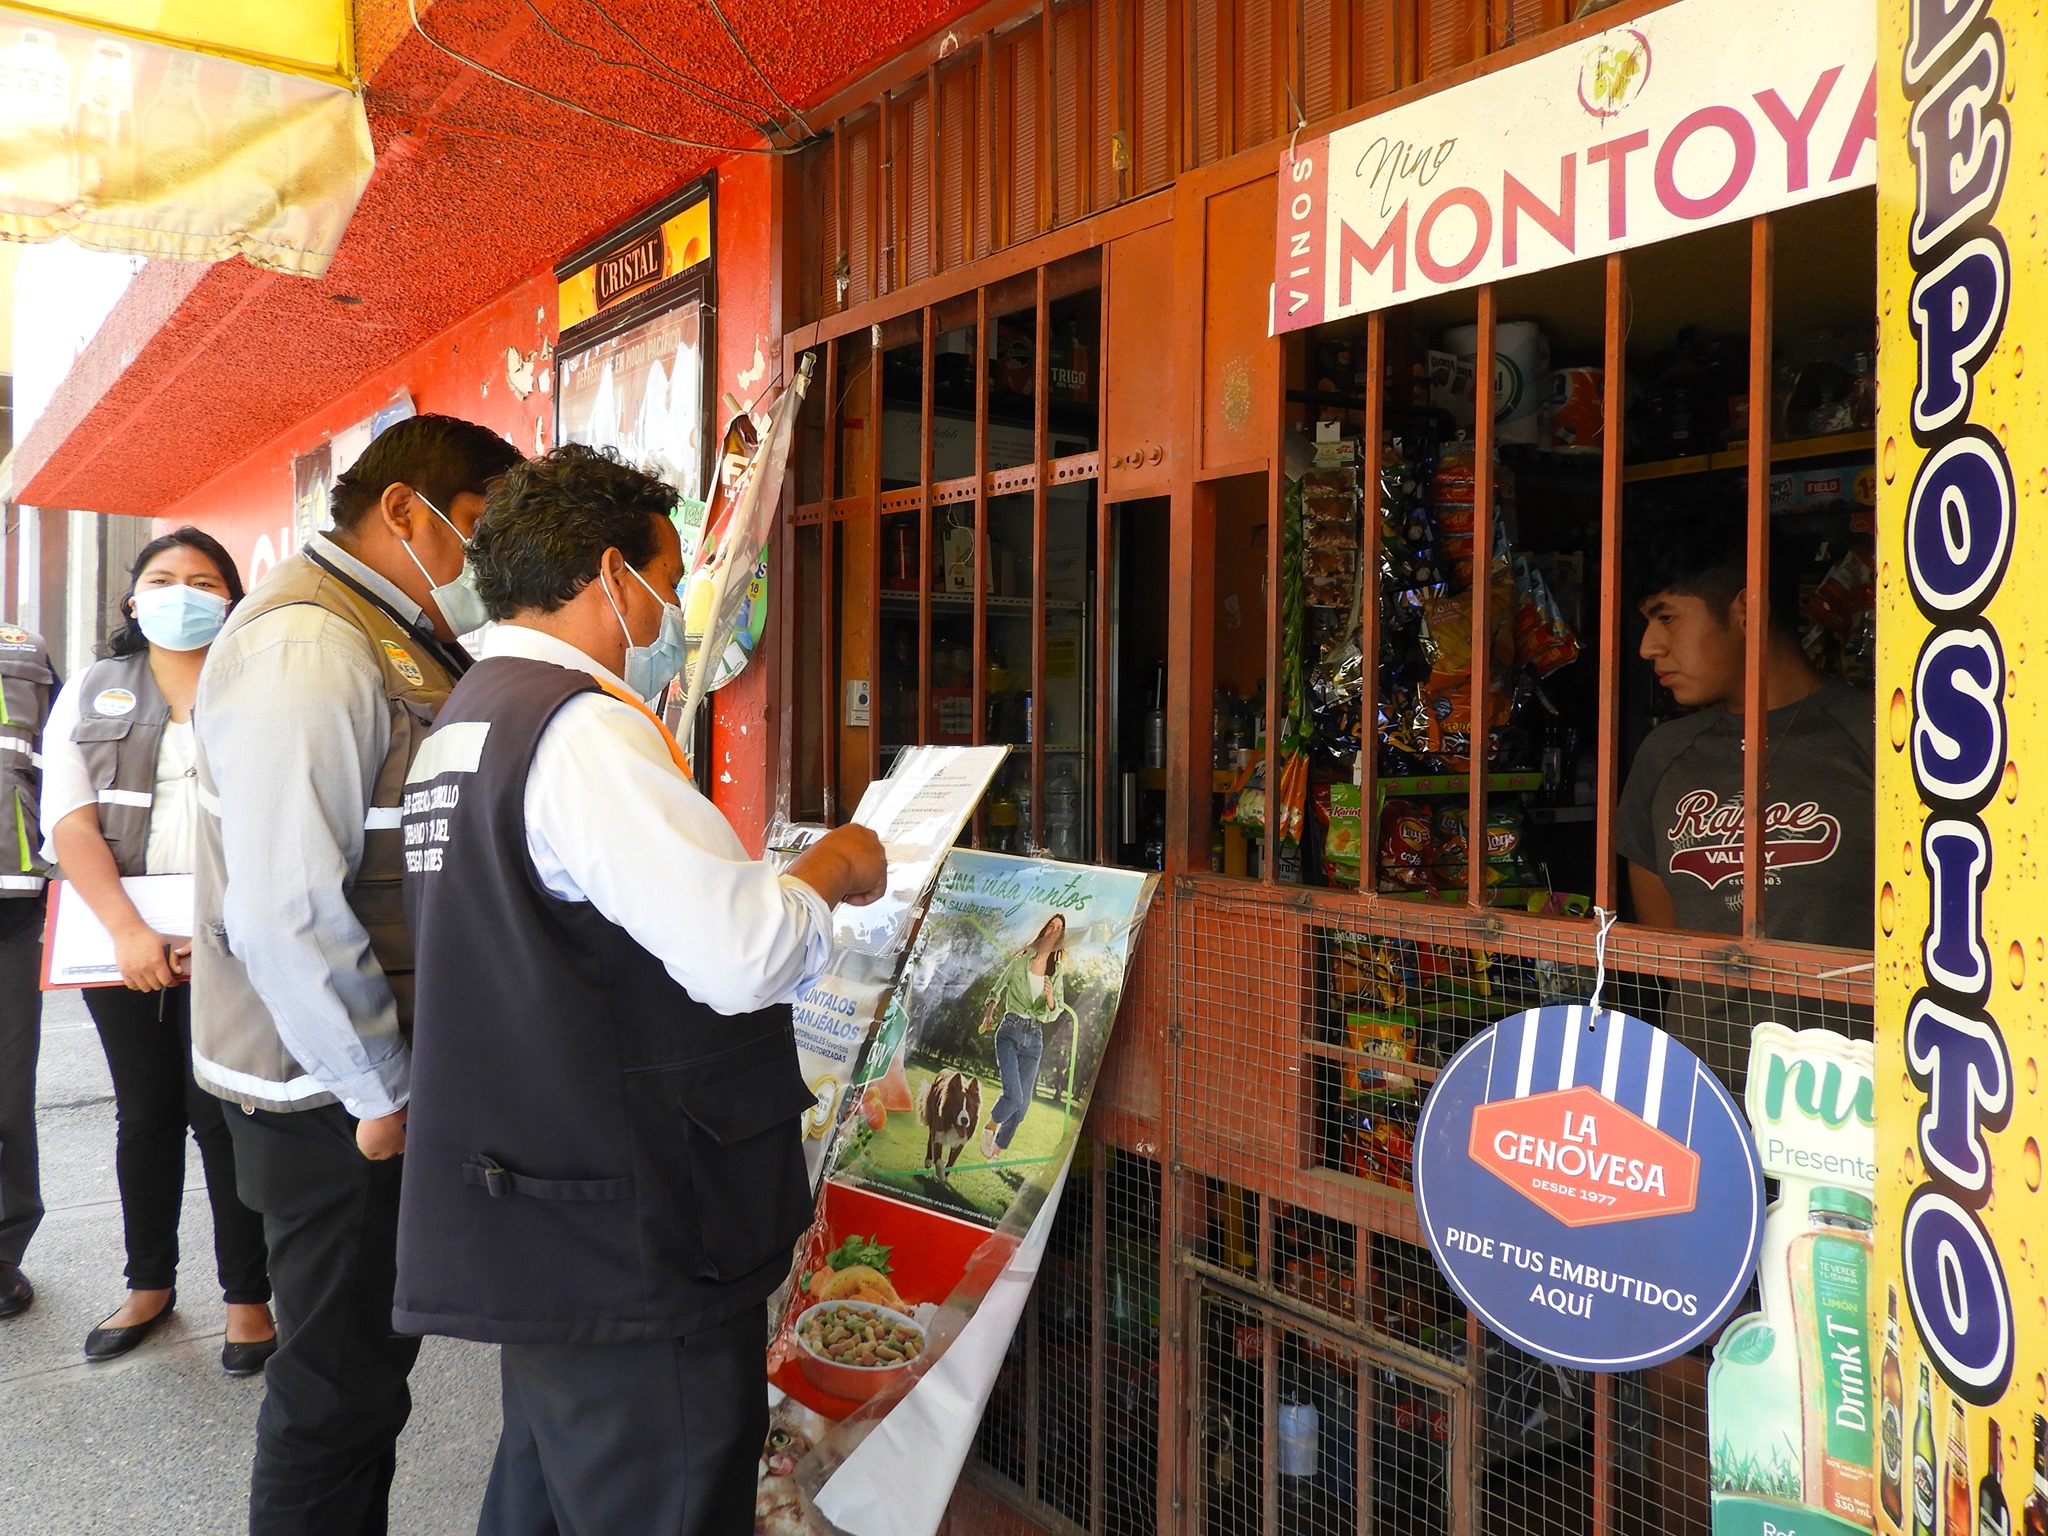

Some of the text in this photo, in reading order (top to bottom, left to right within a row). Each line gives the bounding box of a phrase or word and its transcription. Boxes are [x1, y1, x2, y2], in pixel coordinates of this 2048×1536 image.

[1355, 136, 1459, 218] Nino
[1288, 156, 1312, 314] VINOS
[600, 239, 659, 299] CRISTAL
[615, 351, 625, 374] EN
[626, 342, 645, 370] MODO
[1051, 367, 1086, 385] TRIGO
[1807, 481, 1838, 493] FIELD
[1333, 805, 1361, 819] Karint
[1487, 831, 1515, 852] Lay's
[980, 868, 1022, 901] vida
[1005, 874, 1093, 918] juntos
[809, 1045, 847, 1063] AUTORIZADAS
[1562, 1110, 1598, 1147] LA
[1493, 1129, 1666, 1198] GENOVESA
[1532, 1177, 1617, 1207] DESDE 1977
[1445, 1226, 1699, 1317] PIDE TUS EMBUTIDOS
[1830, 1264, 1857, 1278] VERDE
[1529, 1283, 1595, 1320] AQUÍ
[1822, 1296, 1858, 1313] LIMÓN
[1826, 1314, 1859, 1338] T
[1830, 1345, 1866, 1432] Drink
[1834, 1498, 1873, 1520] 330 mL
